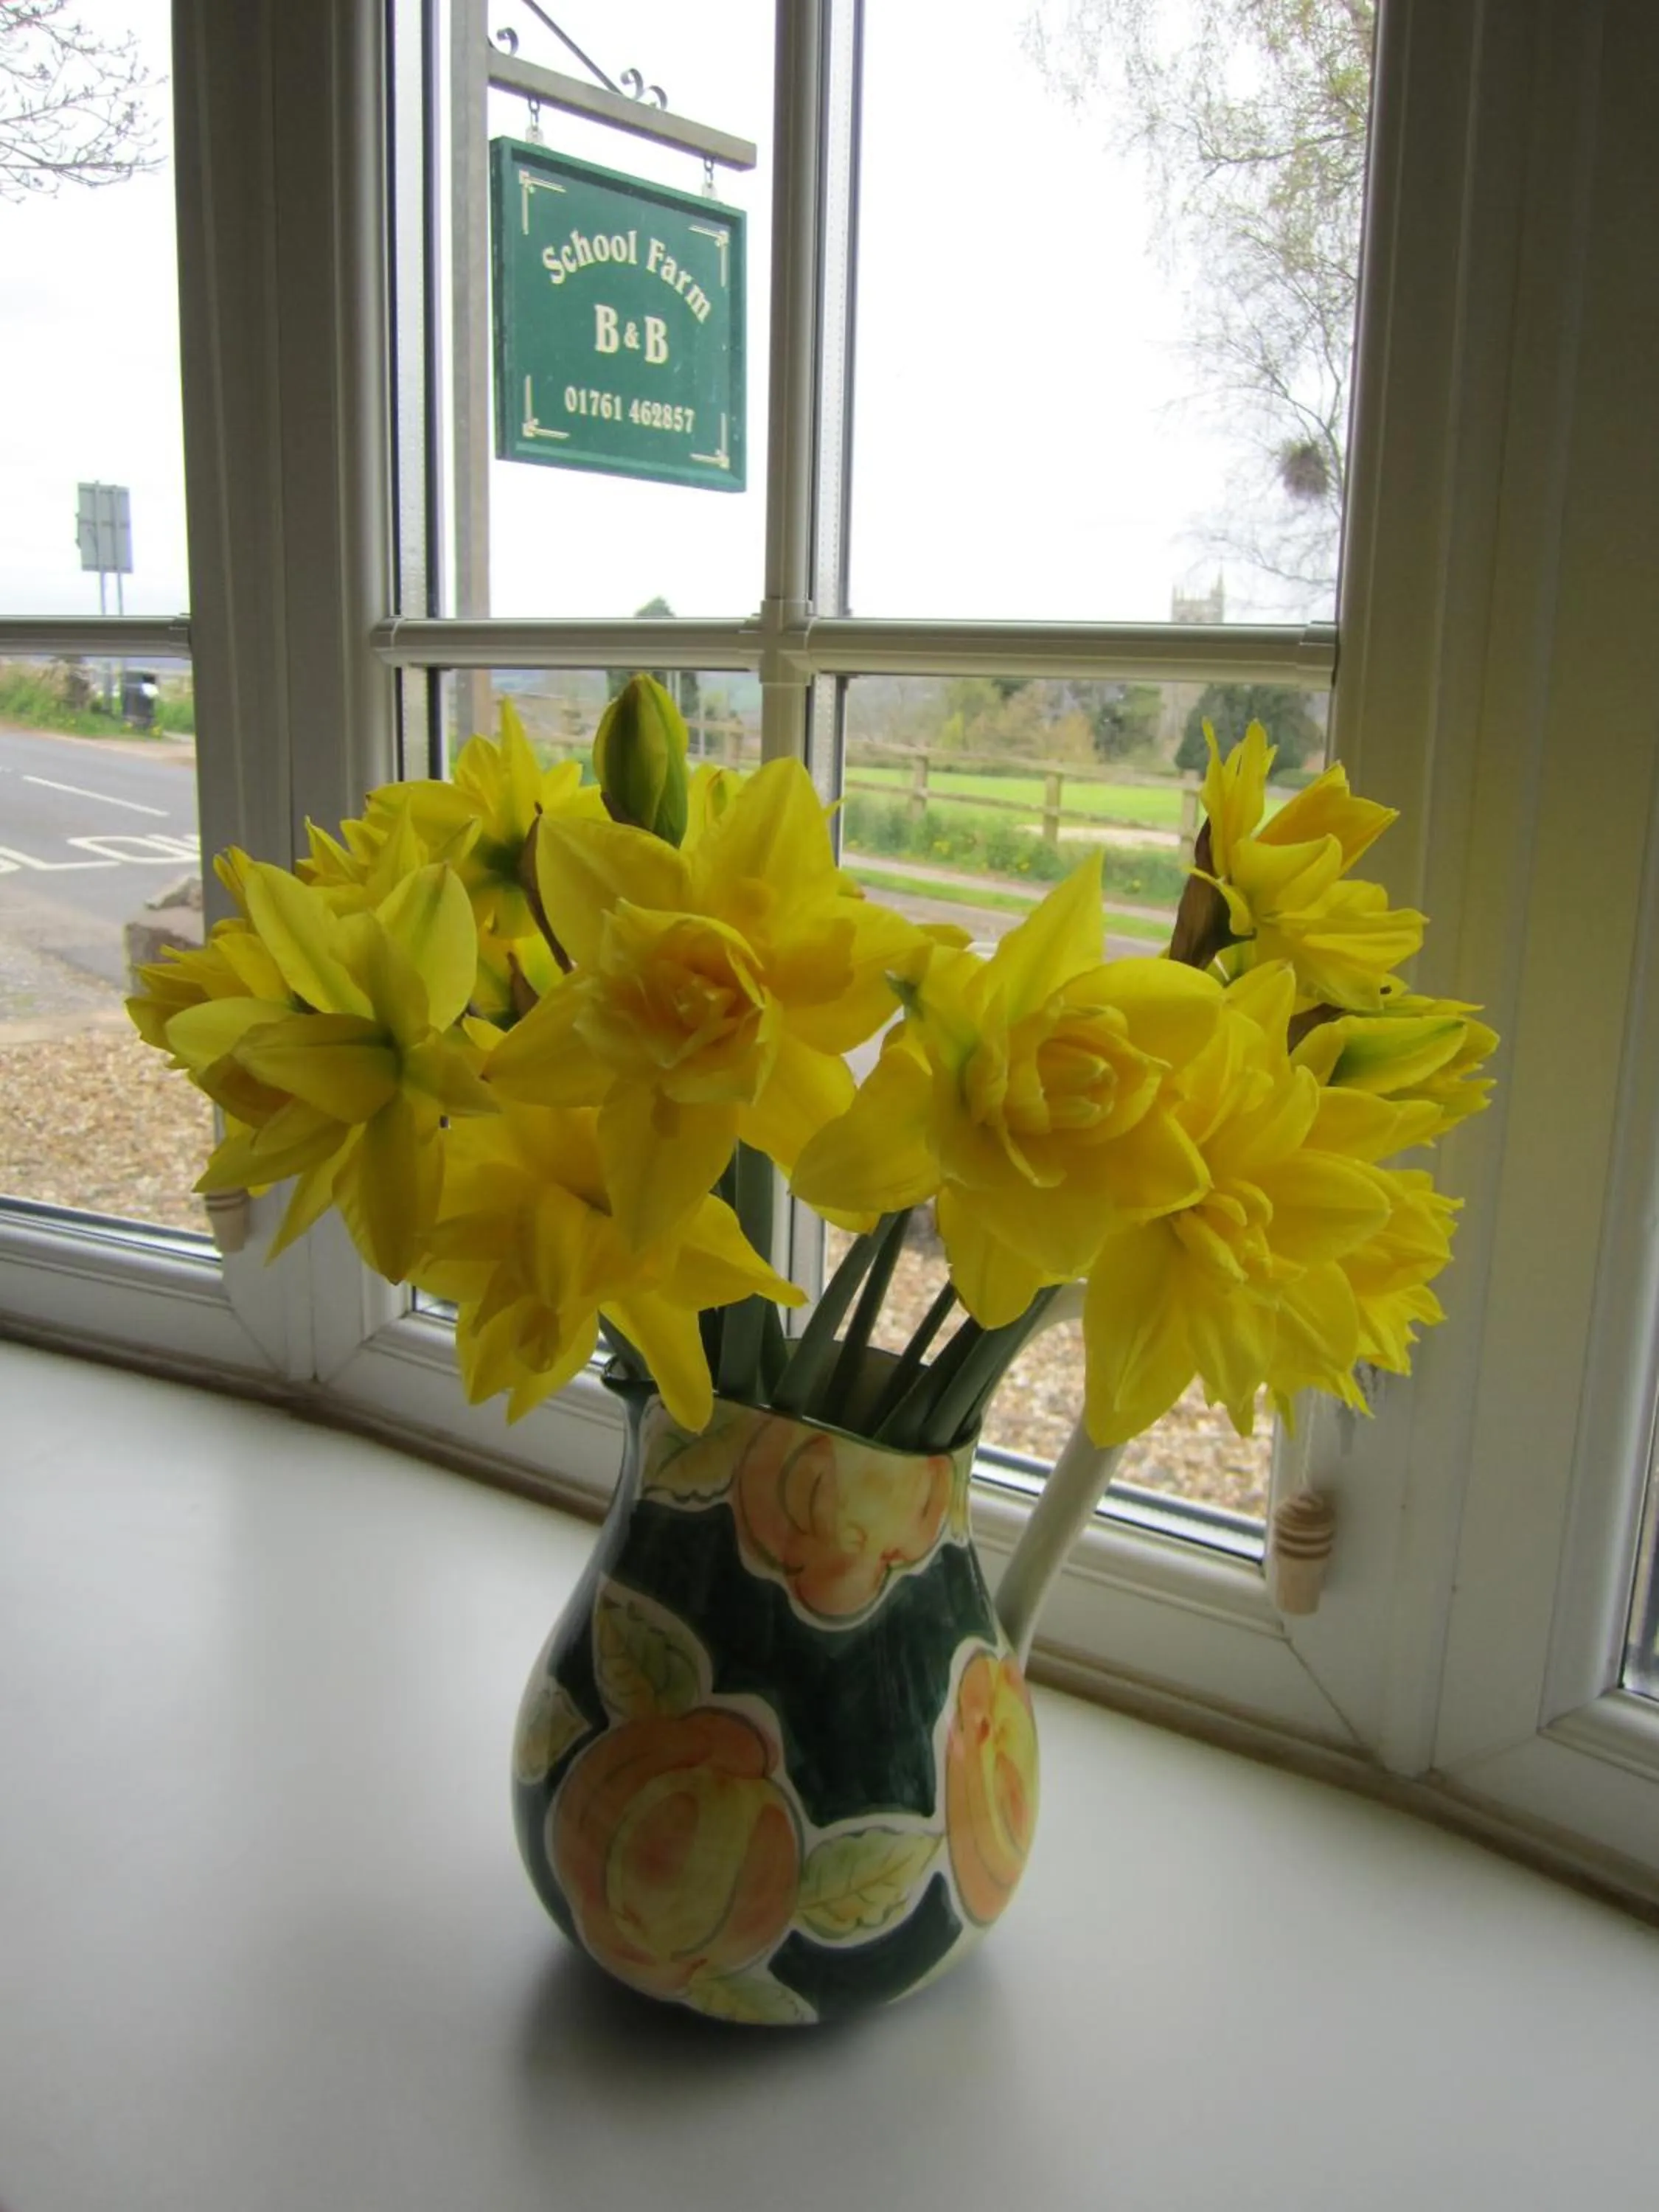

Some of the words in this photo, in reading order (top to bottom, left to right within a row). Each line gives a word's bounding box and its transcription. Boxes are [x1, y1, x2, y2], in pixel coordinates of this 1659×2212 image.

[542, 229, 638, 285] School
[646, 237, 712, 324] Farm
[565, 386, 623, 422] 01761
[629, 398, 695, 434] 462857
